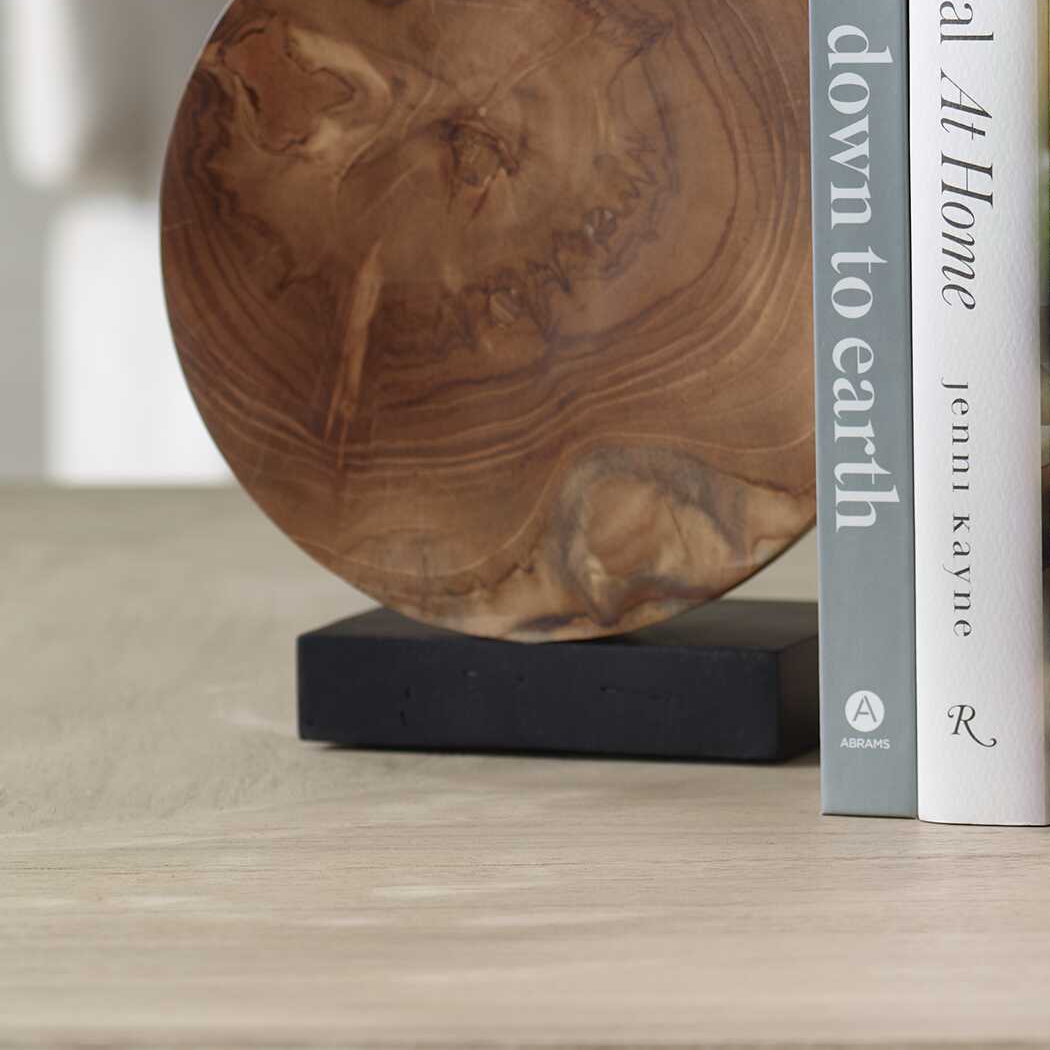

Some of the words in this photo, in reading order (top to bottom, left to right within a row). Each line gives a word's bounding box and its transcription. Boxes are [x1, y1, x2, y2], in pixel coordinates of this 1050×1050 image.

[827, 24, 894, 231] down
[940, 67, 993, 140] At
[940, 150, 994, 311] Home
[830, 246, 889, 320] to
[831, 337, 900, 533] earth
[840, 737, 891, 750] ABRAMS
[947, 704, 997, 748] R
